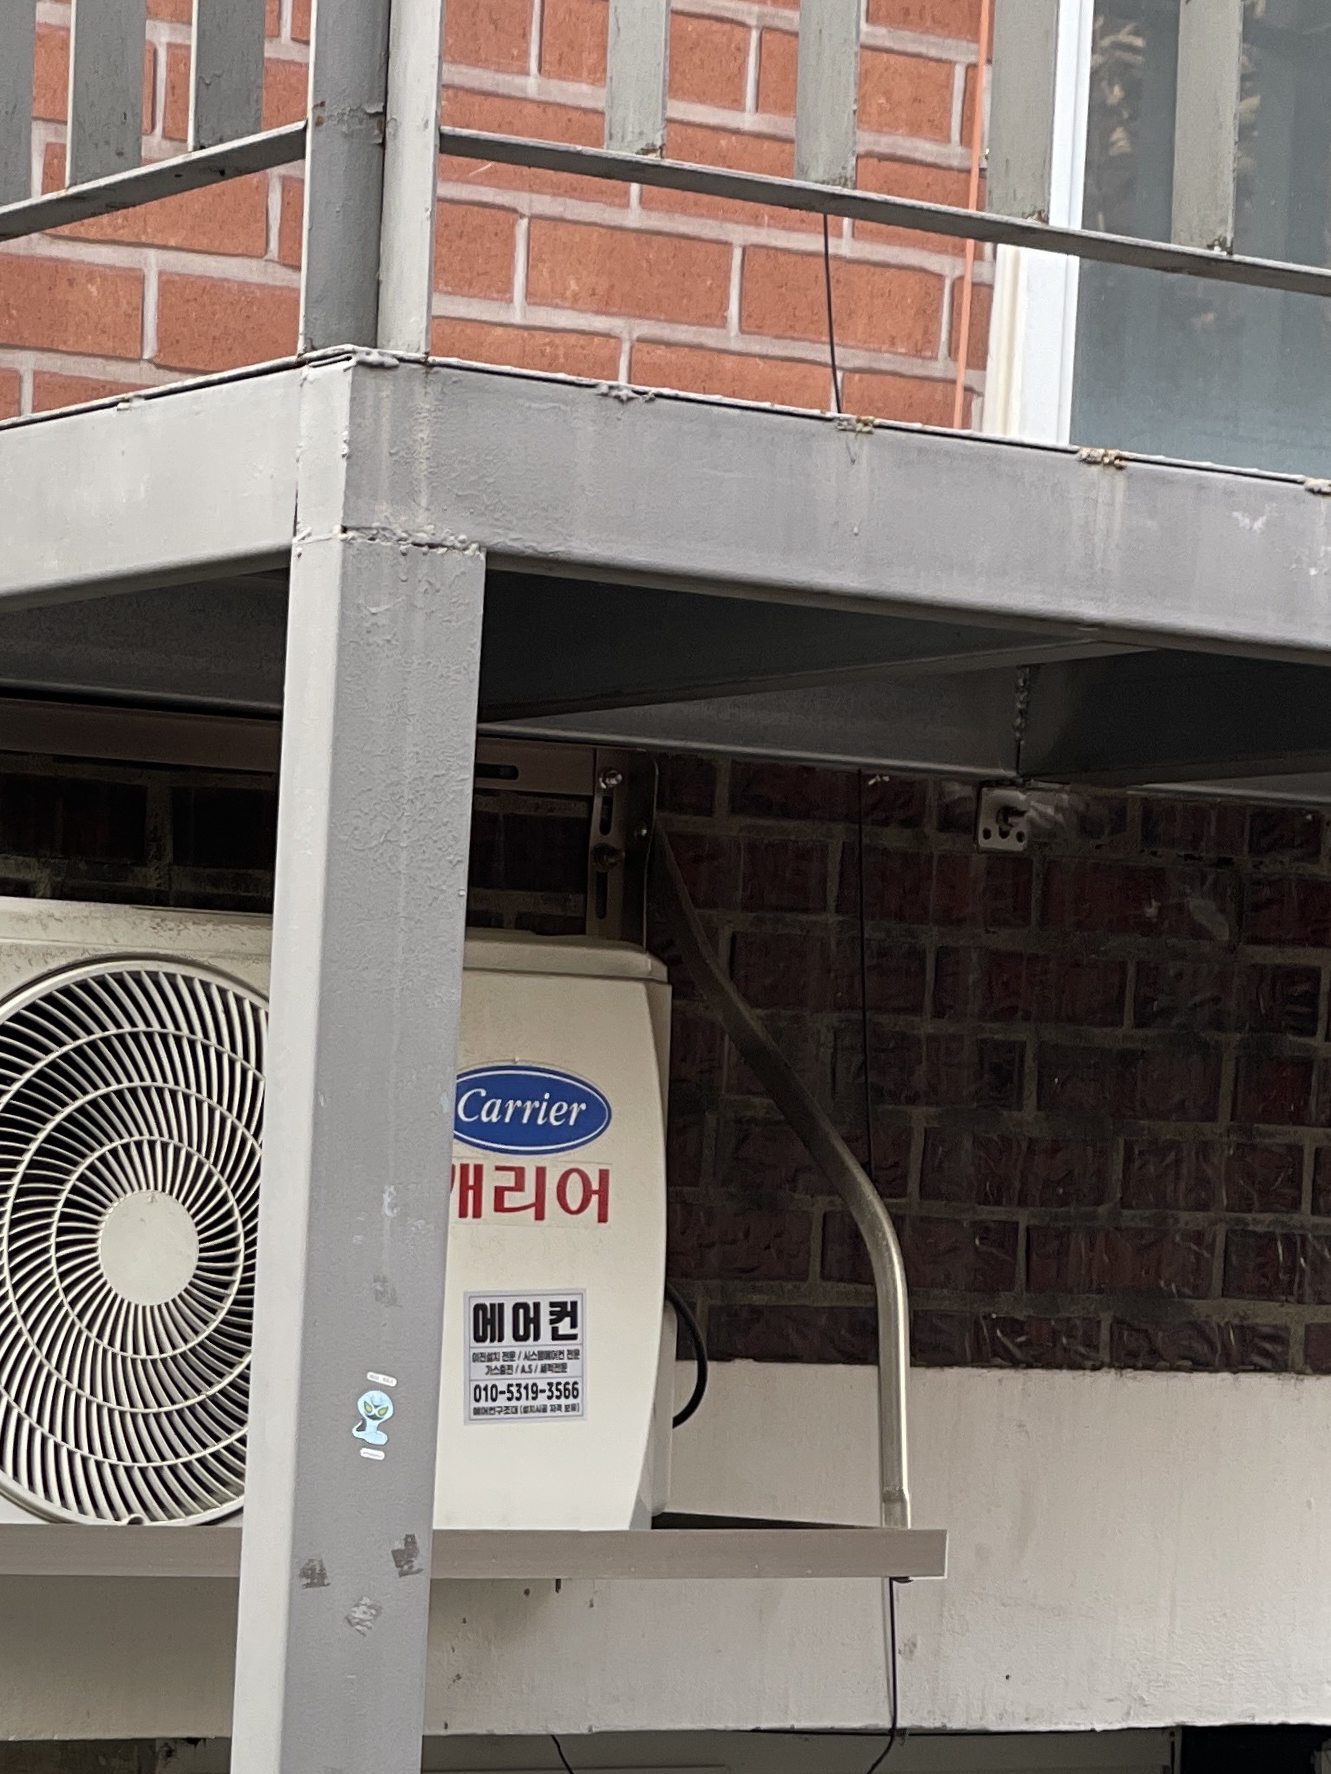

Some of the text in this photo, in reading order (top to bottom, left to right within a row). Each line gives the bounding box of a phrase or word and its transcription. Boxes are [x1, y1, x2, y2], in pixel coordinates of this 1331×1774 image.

[457, 1087, 587, 1127] Carrier
[472, 1300, 578, 1343] 에어컨
[473, 1381, 579, 1403] 010-5319-3566
